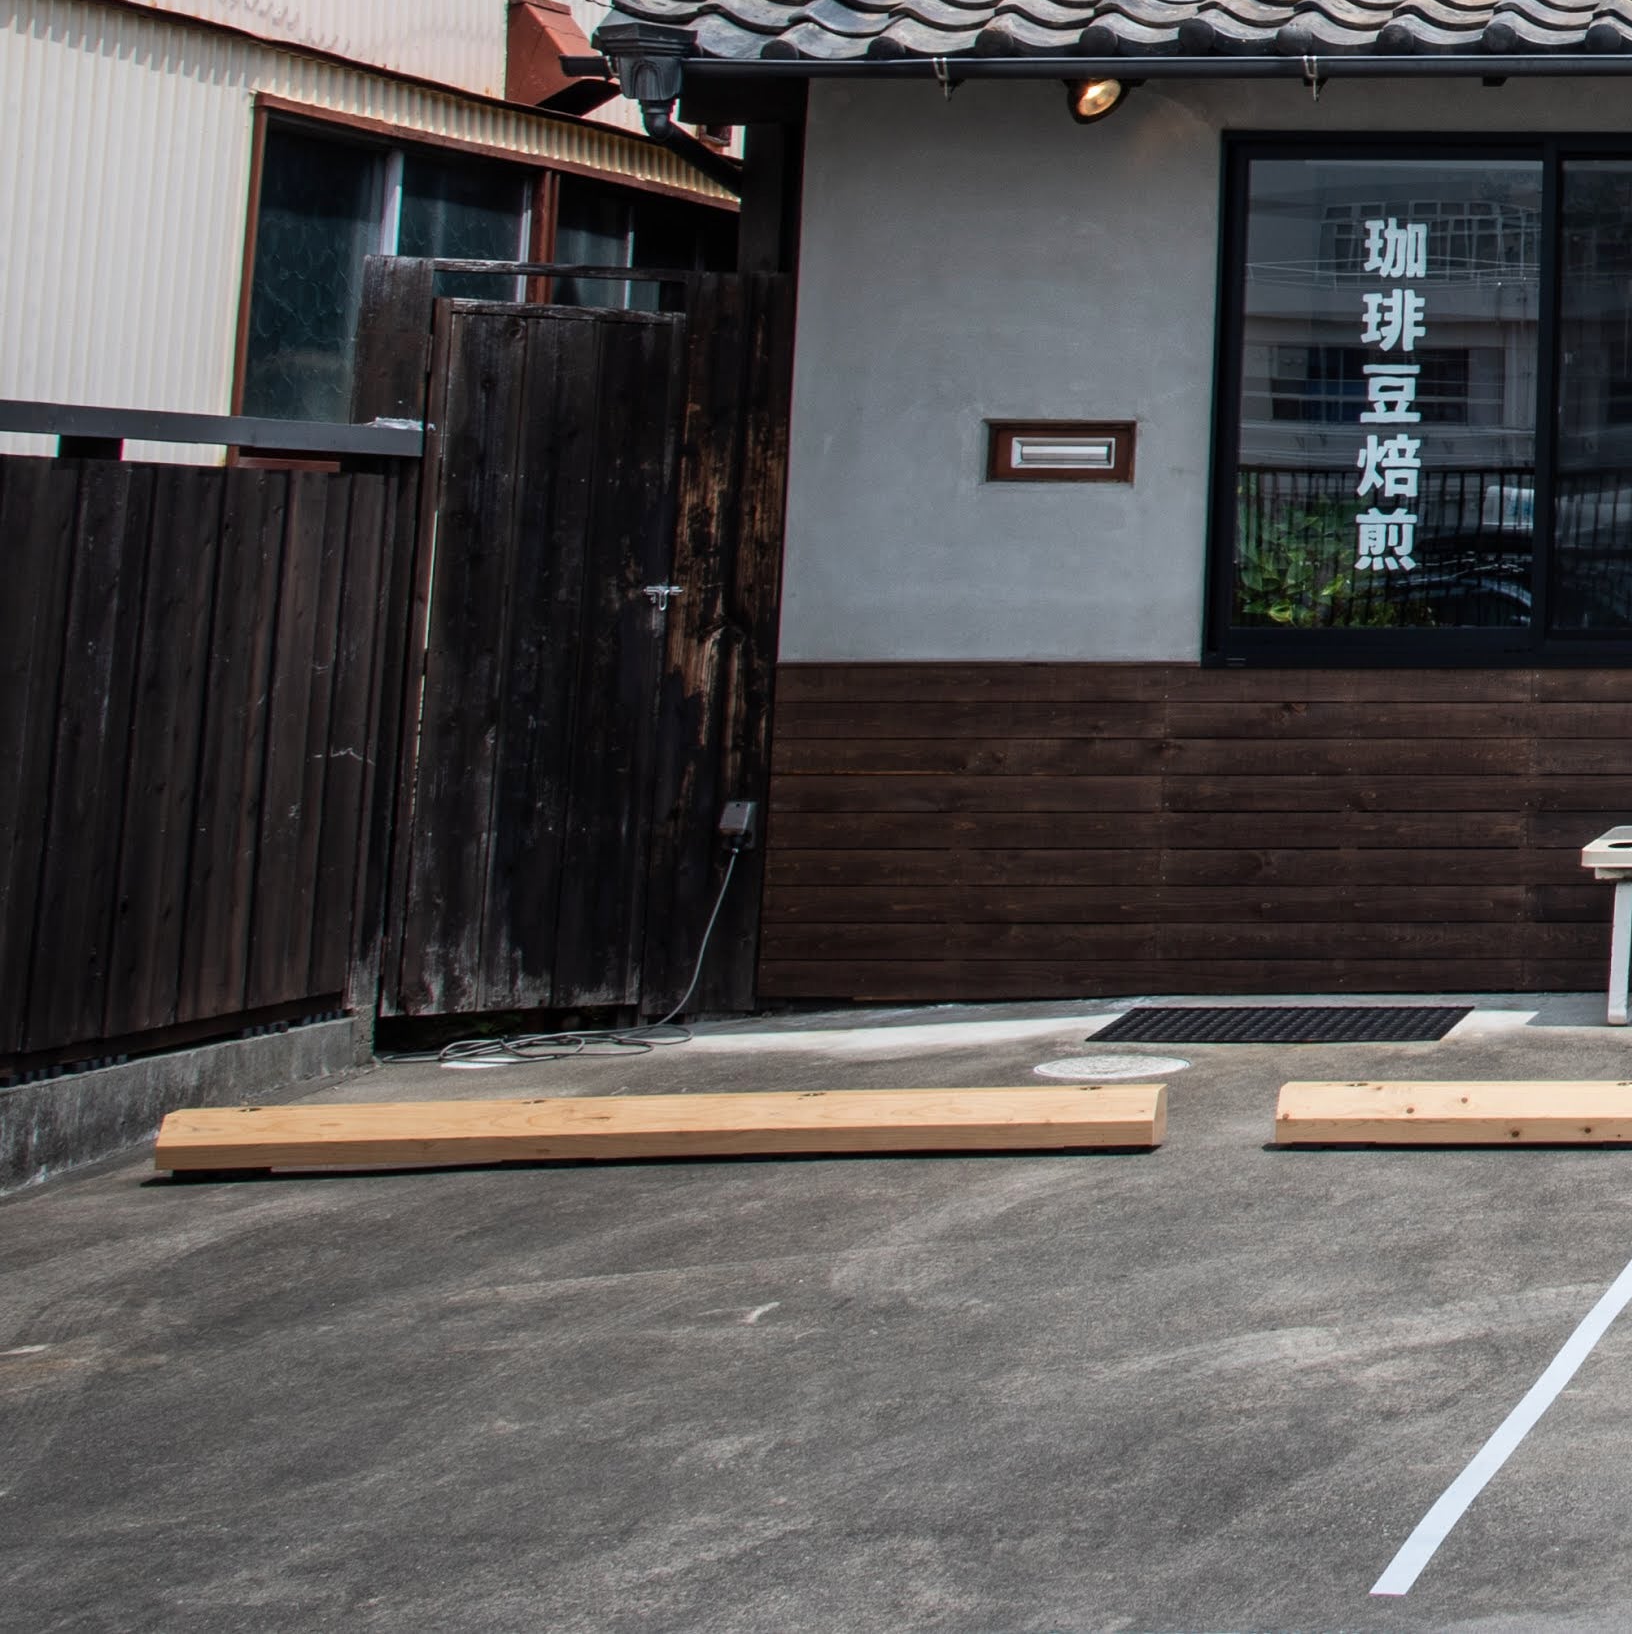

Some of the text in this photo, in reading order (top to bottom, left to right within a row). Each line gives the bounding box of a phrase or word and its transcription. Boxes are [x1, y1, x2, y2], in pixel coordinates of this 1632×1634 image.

[1353, 217, 1428, 572] 珈琲豆焙煎
